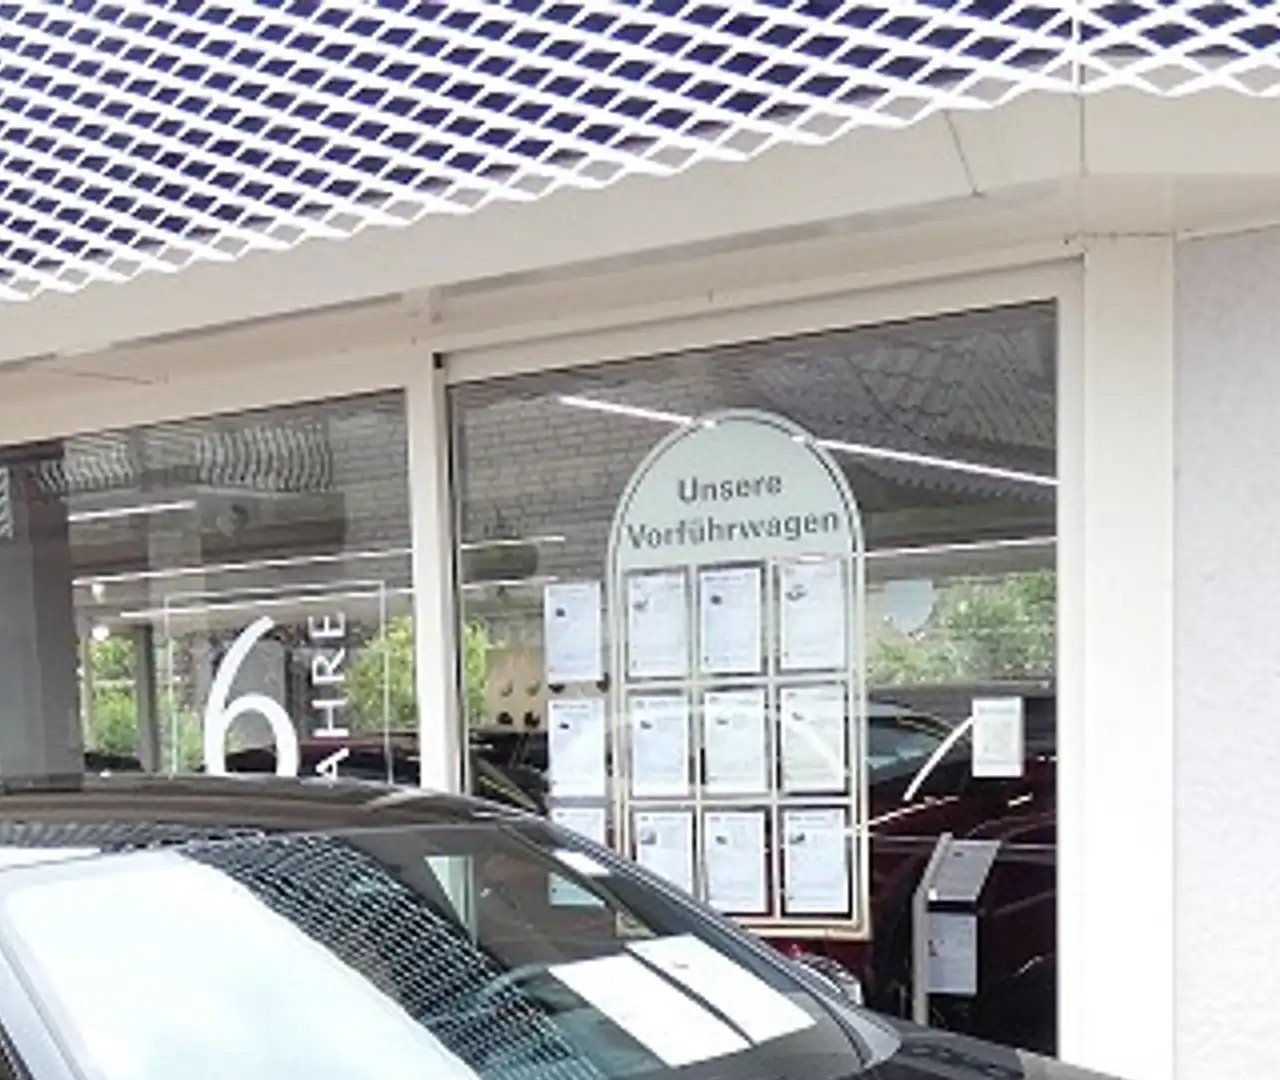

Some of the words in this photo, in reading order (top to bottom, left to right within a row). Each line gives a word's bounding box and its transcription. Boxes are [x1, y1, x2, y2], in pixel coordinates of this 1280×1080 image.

[677, 475, 782, 505] Unsere
[627, 511, 839, 549] Vorführwagen
[204, 616, 299, 778] 6
